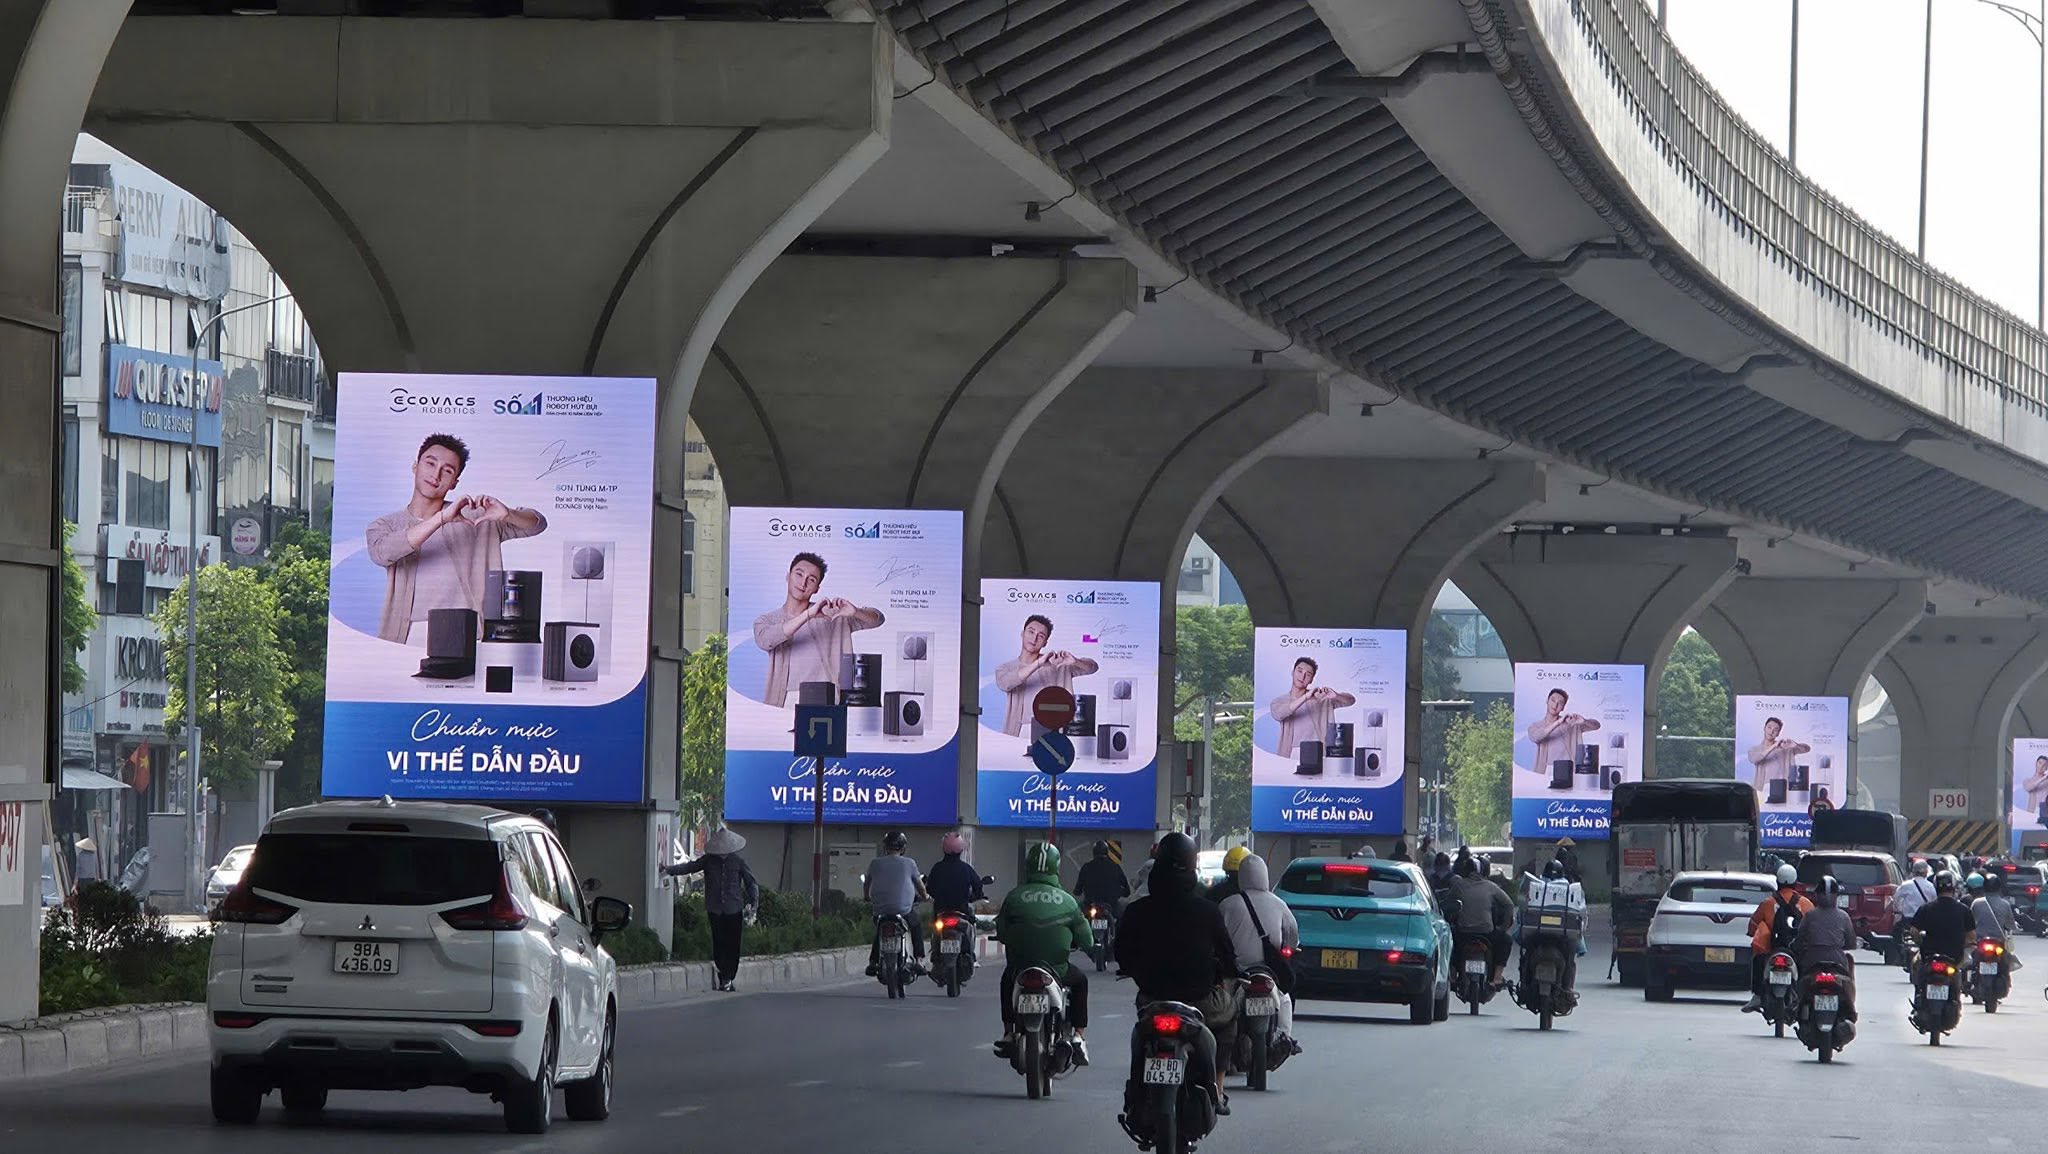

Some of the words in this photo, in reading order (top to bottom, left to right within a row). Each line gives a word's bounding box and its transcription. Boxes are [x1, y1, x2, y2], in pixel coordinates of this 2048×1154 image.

[119, 185, 165, 238] BERRY
[392, 392, 476, 408] ECOVACS
[493, 393, 522, 415] SỐ
[422, 407, 476, 415] ROBOTICS
[770, 521, 832, 534] ECOVACS
[844, 522, 865, 538] SỐ
[1008, 591, 1057, 600] ECOVACS
[1066, 591, 1083, 604] SỐ
[410, 708, 498, 741] Chuẩn
[505, 722, 559, 741] mực
[387, 750, 408, 775] VỊ
[416, 745, 466, 772] THẾ
[471, 744, 522, 773] DẪN
[529, 747, 580, 774] ĐẦU
[857, 766, 896, 780] mực
[771, 786, 787, 804] VỊ
[832, 782, 870, 803] DẪN
[874, 783, 912, 804] ĐẦU
[1933, 793, 1966, 809] P90
[1009, 799, 1021, 814] VỊ
[1057, 795, 1087, 812] DẪN
[1090, 797, 1120, 813] ĐẦU
[1281, 809, 1292, 822] VỊ
[1295, 806, 1319, 820] THẾ
[1321, 806, 1346, 820] DẪN
[1349, 807, 1373, 821] ĐẦU
[1537, 818, 1546, 829] VỊ
[1549, 815, 1569, 827] THẾ
[1571, 815, 1593, 828] DẪN
[1021, 890, 1063, 904] Grab
[353, 943, 380, 957] 98A
[341, 958, 392, 972] 436.09
